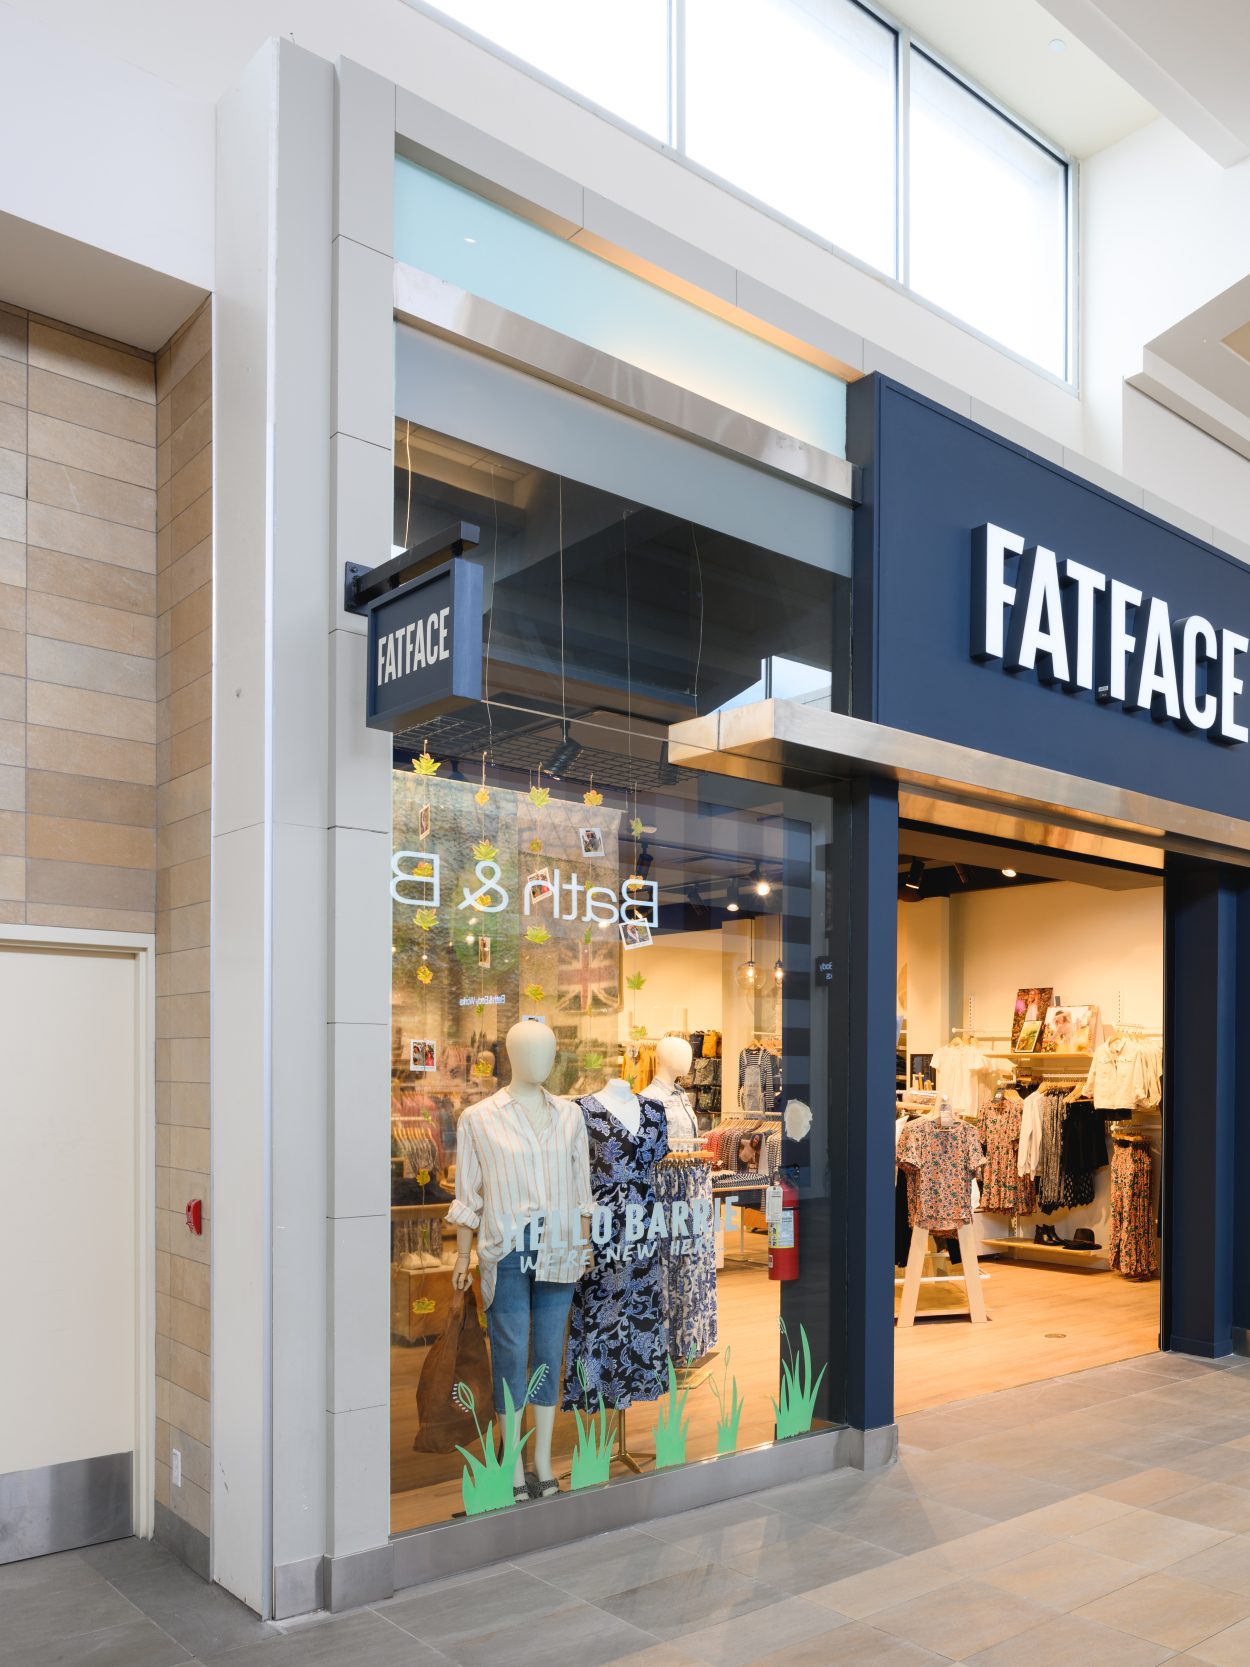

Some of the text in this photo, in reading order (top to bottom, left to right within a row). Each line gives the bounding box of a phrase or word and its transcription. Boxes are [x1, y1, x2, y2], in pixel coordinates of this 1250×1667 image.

[377, 606, 450, 686] FATFACE
[972, 522, 1249, 744] FATFACE
[500, 1205, 613, 1252] HELLO
[625, 1195, 740, 1242] BARRIE
